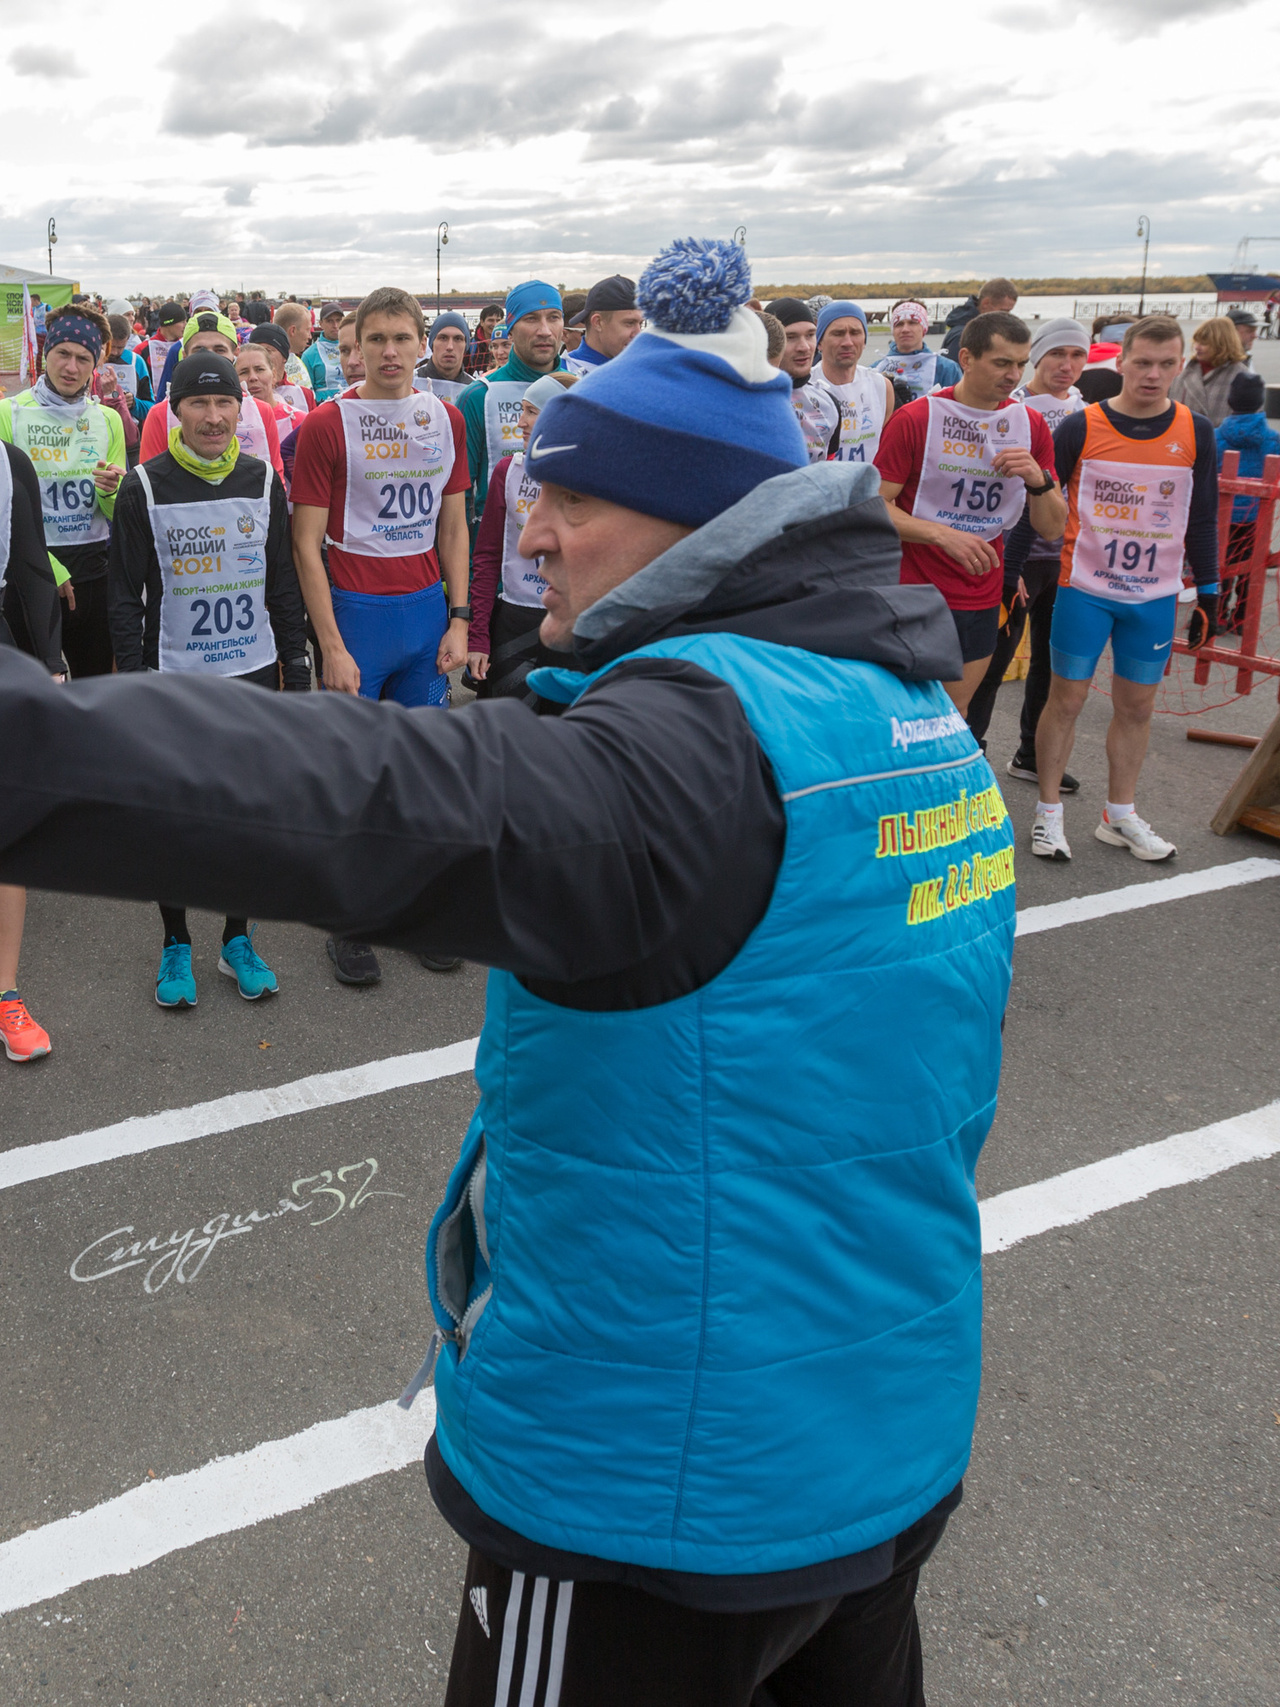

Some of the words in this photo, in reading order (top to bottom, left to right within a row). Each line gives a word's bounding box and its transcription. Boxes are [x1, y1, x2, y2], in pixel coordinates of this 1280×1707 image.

[6, 292, 24, 300] СПОР
[7, 307, 24, 315] ЖИЗ
[359, 414, 390, 428] КРО
[943, 415, 980, 432] КРОСС
[27, 424, 62, 435] КРОСС
[942, 427, 989, 444] НАЦИИ
[30, 447, 68, 462] 2021
[364, 442, 408, 460] 2021
[942, 440, 984, 460] 2021
[365, 471, 388, 480] СПОРТ
[393, 469, 422, 479] НОРМА
[938, 463, 962, 473] СПОРТ
[1095, 480, 1134, 493] КРОСС
[46, 478, 96, 511] 169
[378, 481, 434, 519] 200
[951, 478, 1004, 513] 156
[1094, 491, 1145, 506] НАЦИИ
[936, 510, 1003, 525] АРХАНГЕЛЬСКАЯ
[1093, 503, 1138, 521] 2021
[58, 523, 91, 534] ОБЛАСТЬ
[166, 526, 212, 542] КРОСС
[385, 530, 424, 541] ОБЛАСТЬ
[1090, 525, 1114, 535] СПОРТ
[169, 539, 226, 557] НАЦИИ
[1104, 539, 1157, 572] 191
[172, 556, 222, 576] 2021
[1093, 570, 1159, 584] АРХАНГЕЛЬСКАЯ
[172, 586, 199, 596] СПОРТ
[206, 583, 238, 594] НОРМА
[1108, 581, 1145, 593] ОБЛАСТЬ
[190, 593, 255, 636] 203
[203, 648, 246, 663] ОБЛАСТЬ
